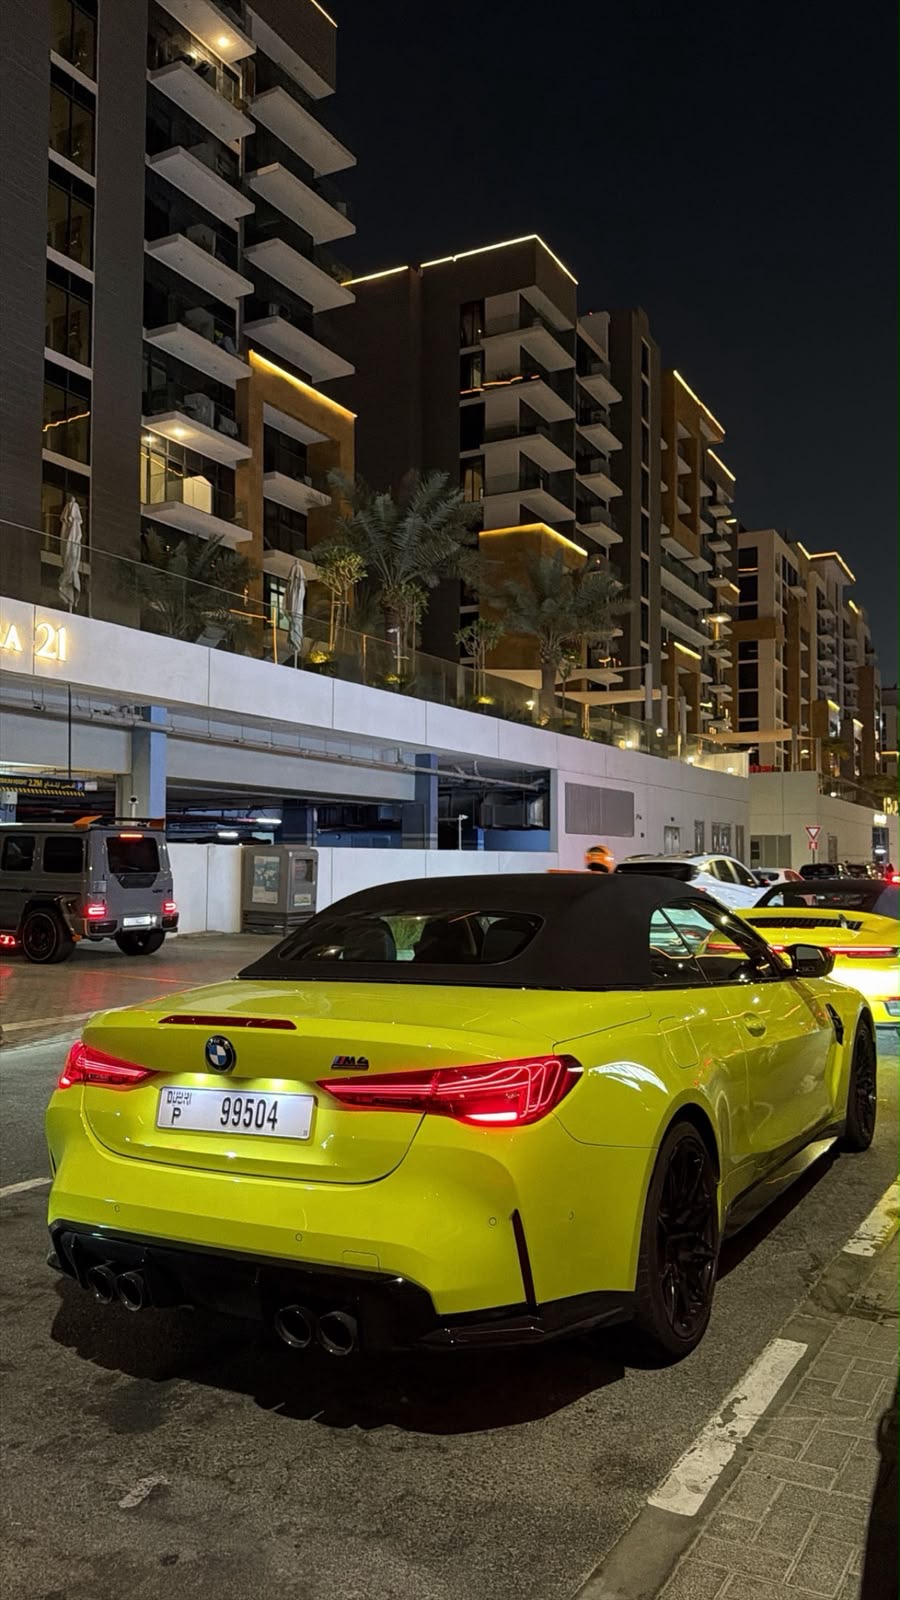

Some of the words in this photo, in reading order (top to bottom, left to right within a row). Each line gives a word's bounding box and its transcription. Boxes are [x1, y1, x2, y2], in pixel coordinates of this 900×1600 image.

[34, 622, 68, 662] 21
[171, 1107, 182, 1125] P
[220, 1097, 279, 1131] 99504
